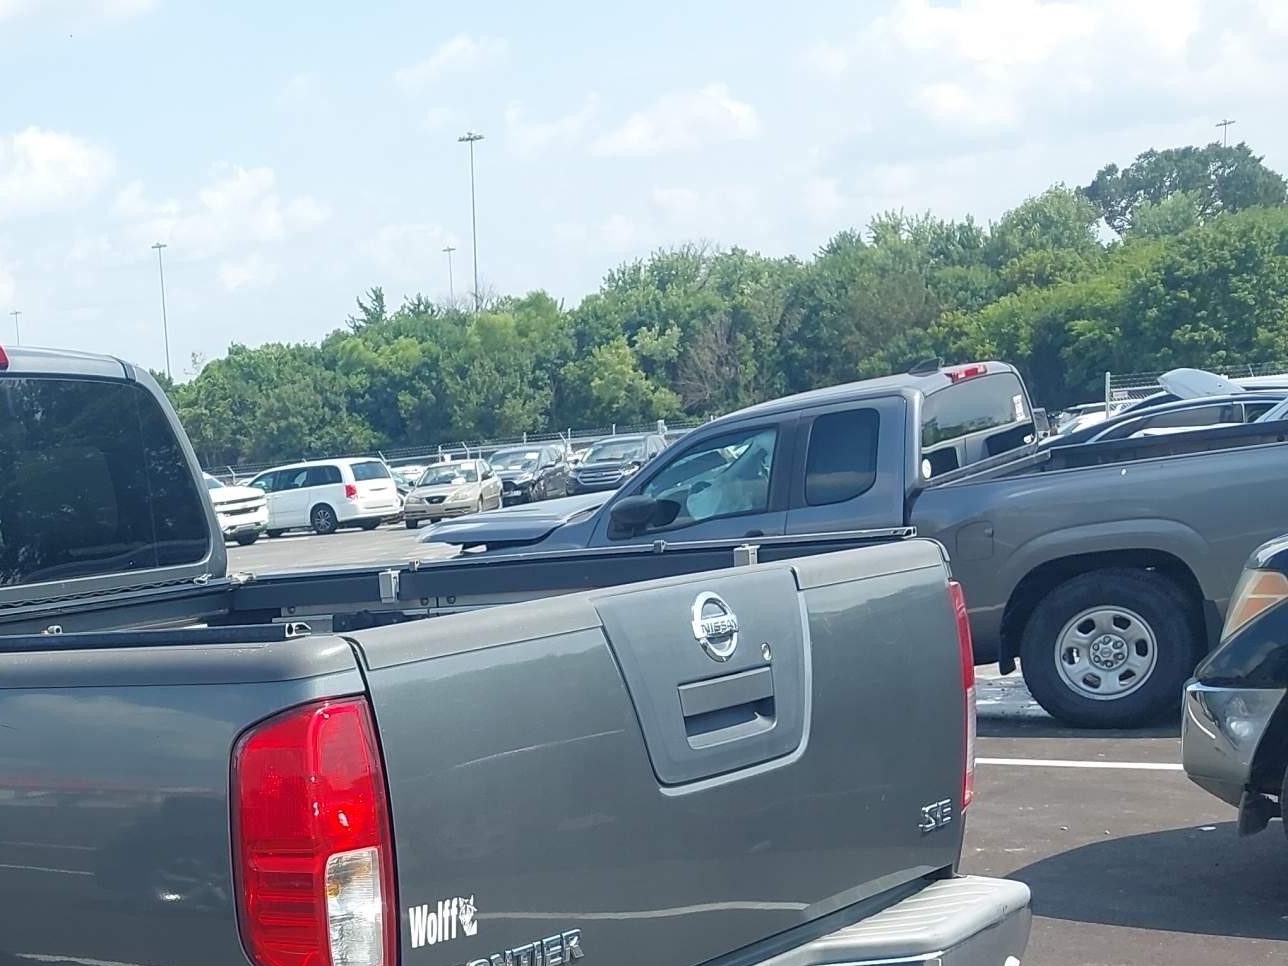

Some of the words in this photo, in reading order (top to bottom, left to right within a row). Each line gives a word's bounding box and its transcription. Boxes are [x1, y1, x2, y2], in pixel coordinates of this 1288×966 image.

[701, 619, 738, 633] NISSAN
[918, 798, 952, 832] SE
[408, 897, 459, 949] Wolff
